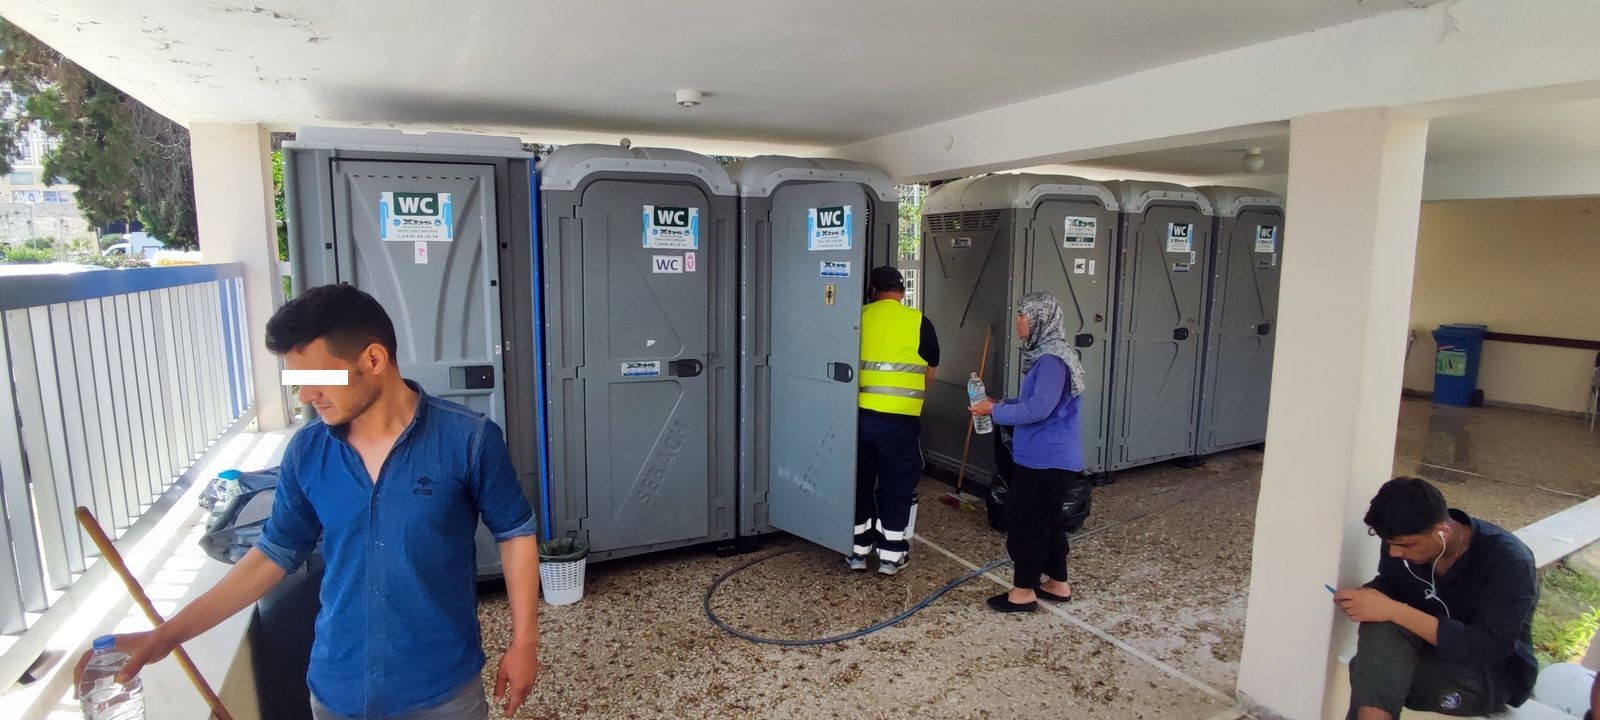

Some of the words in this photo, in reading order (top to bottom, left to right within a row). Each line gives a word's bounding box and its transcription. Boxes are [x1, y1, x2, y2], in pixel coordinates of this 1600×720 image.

[397, 196, 434, 214] WC
[657, 209, 686, 226] WC
[819, 210, 842, 227] WC
[1173, 225, 1187, 237] WC
[1261, 228, 1272, 238] WC
[655, 258, 679, 271] WC
